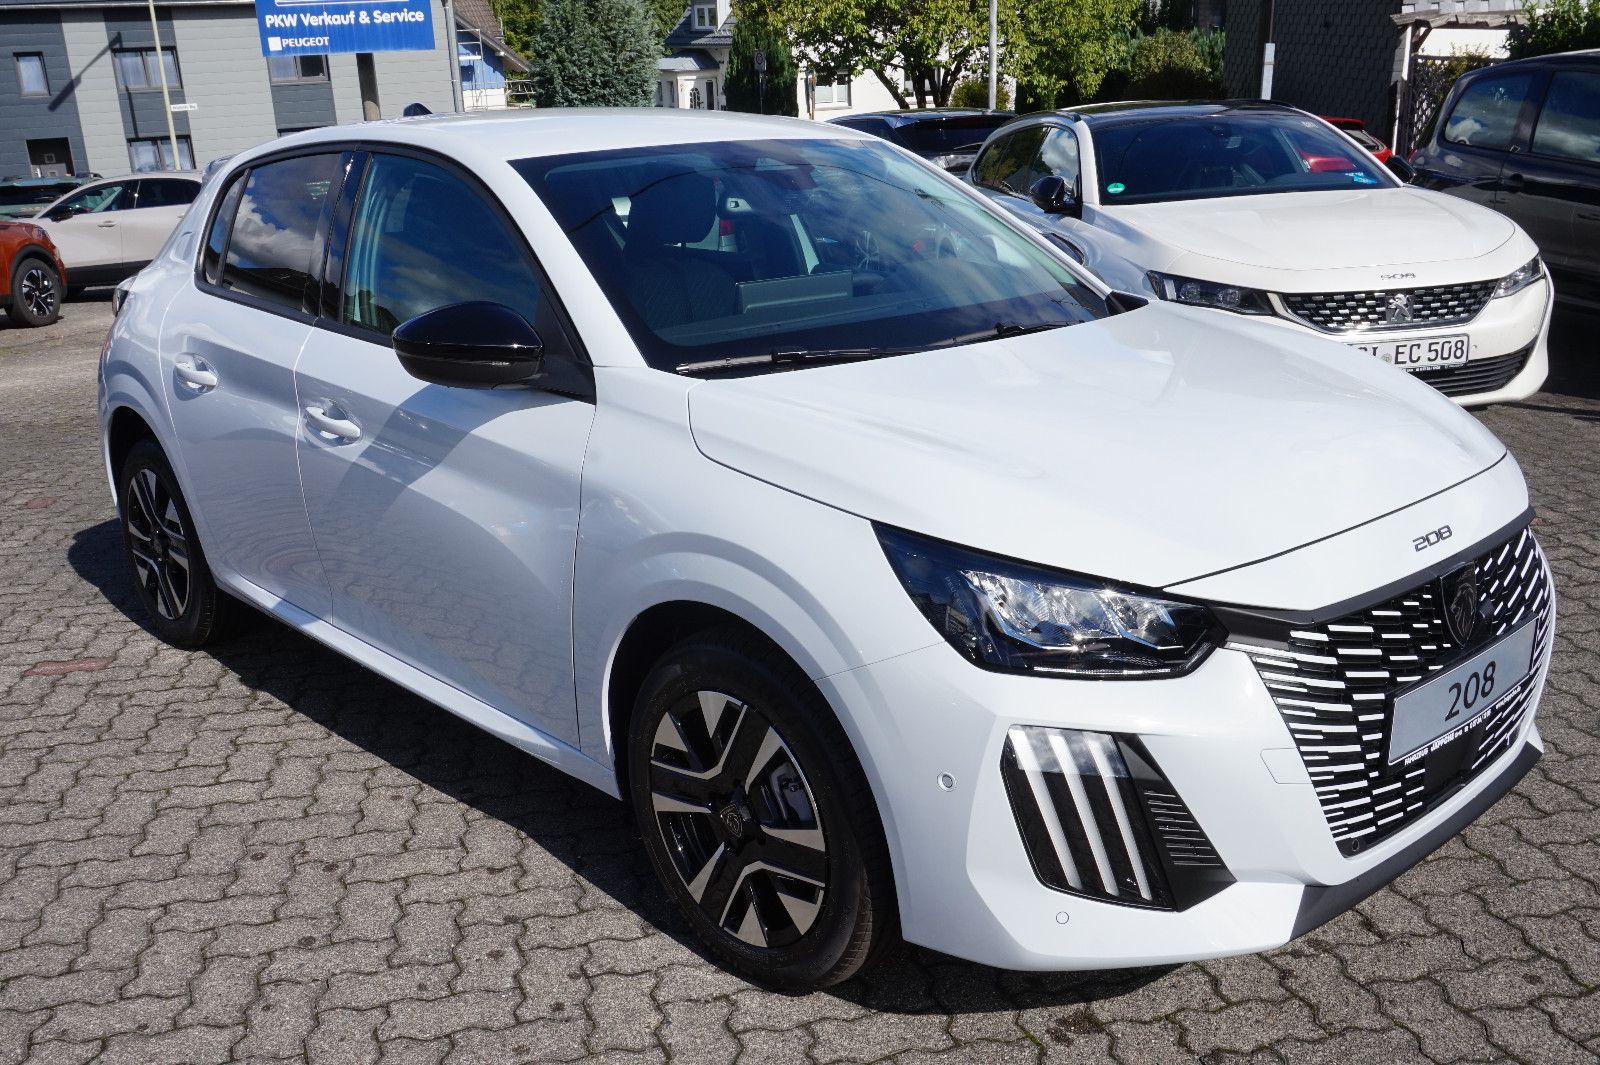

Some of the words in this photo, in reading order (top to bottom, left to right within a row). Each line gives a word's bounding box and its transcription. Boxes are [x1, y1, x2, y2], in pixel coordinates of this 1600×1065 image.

[265, 14, 298, 28] PKW
[300, 11, 355, 27] Verkauf
[358, 10, 370, 24] &
[373, 8, 425, 23] Service
[282, 36, 330, 48] PEUGEOT
[1394, 343, 1421, 365] EC
[1427, 340, 1465, 362] 508
[1412, 525, 1453, 552] 208
[1444, 660, 1497, 722] 208
